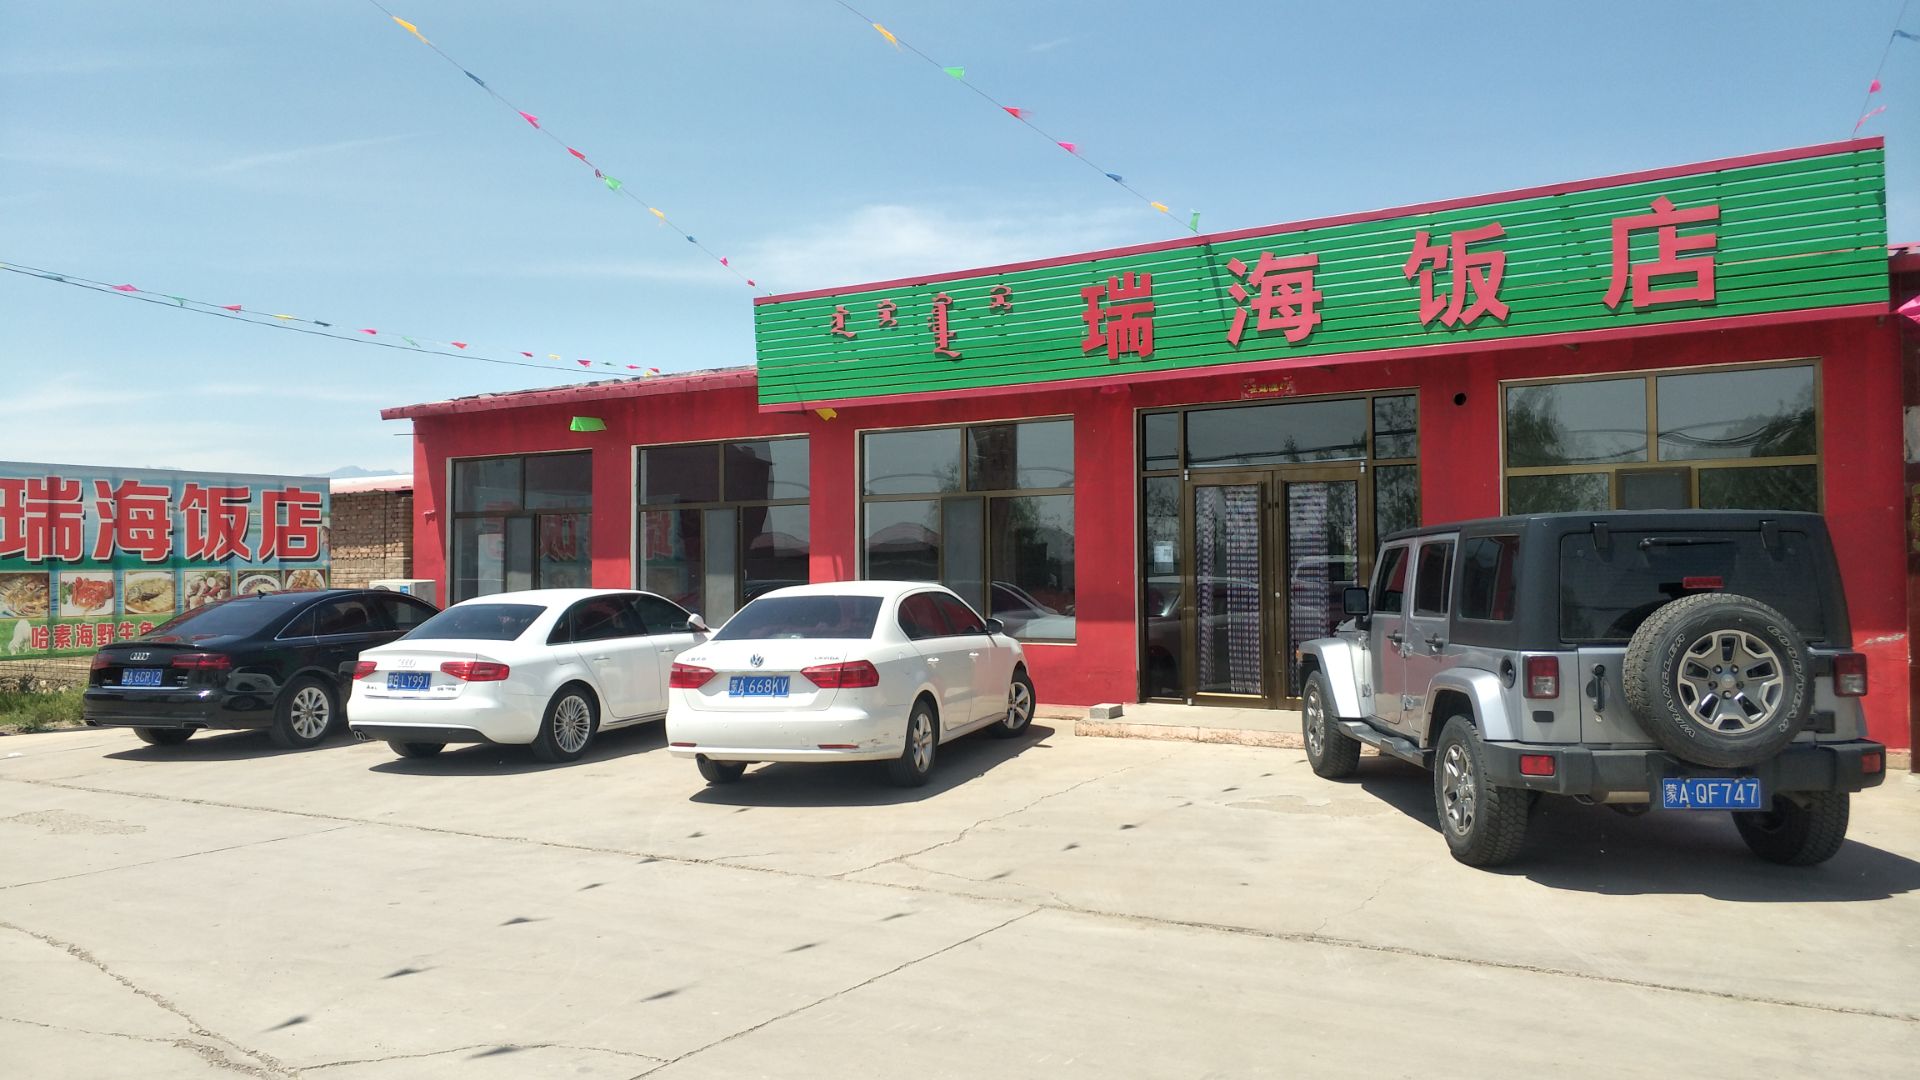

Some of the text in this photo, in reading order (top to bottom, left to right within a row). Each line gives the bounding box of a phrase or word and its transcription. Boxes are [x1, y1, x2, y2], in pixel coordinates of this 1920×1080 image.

[1080, 195, 1720, 361] 瑞海饭店
[0, 476, 323, 561] 瑞海饭店
[1660, 633, 1696, 738] WRANGLER
[1766, 625, 1807, 733] GOODYEAR
